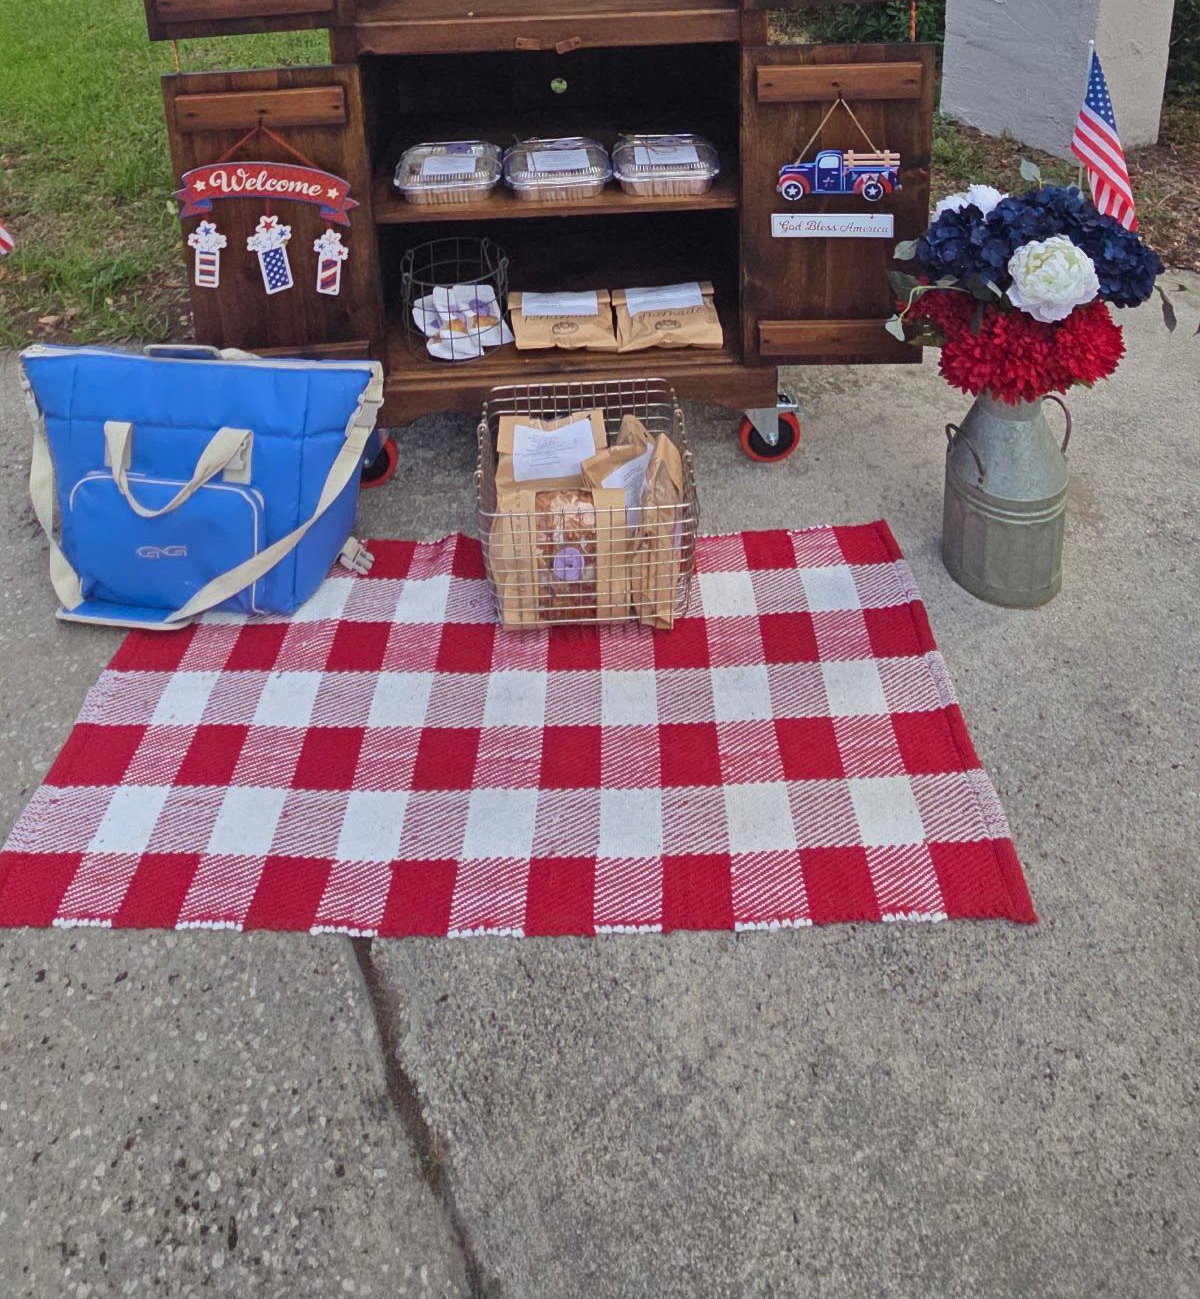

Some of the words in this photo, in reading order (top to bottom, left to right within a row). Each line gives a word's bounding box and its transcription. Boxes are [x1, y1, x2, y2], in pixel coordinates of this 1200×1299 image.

[209, 168, 323, 196] Welcome
[779, 220, 802, 233] God
[805, 220, 836, 231] Bless
[840, 222, 888, 232] America
